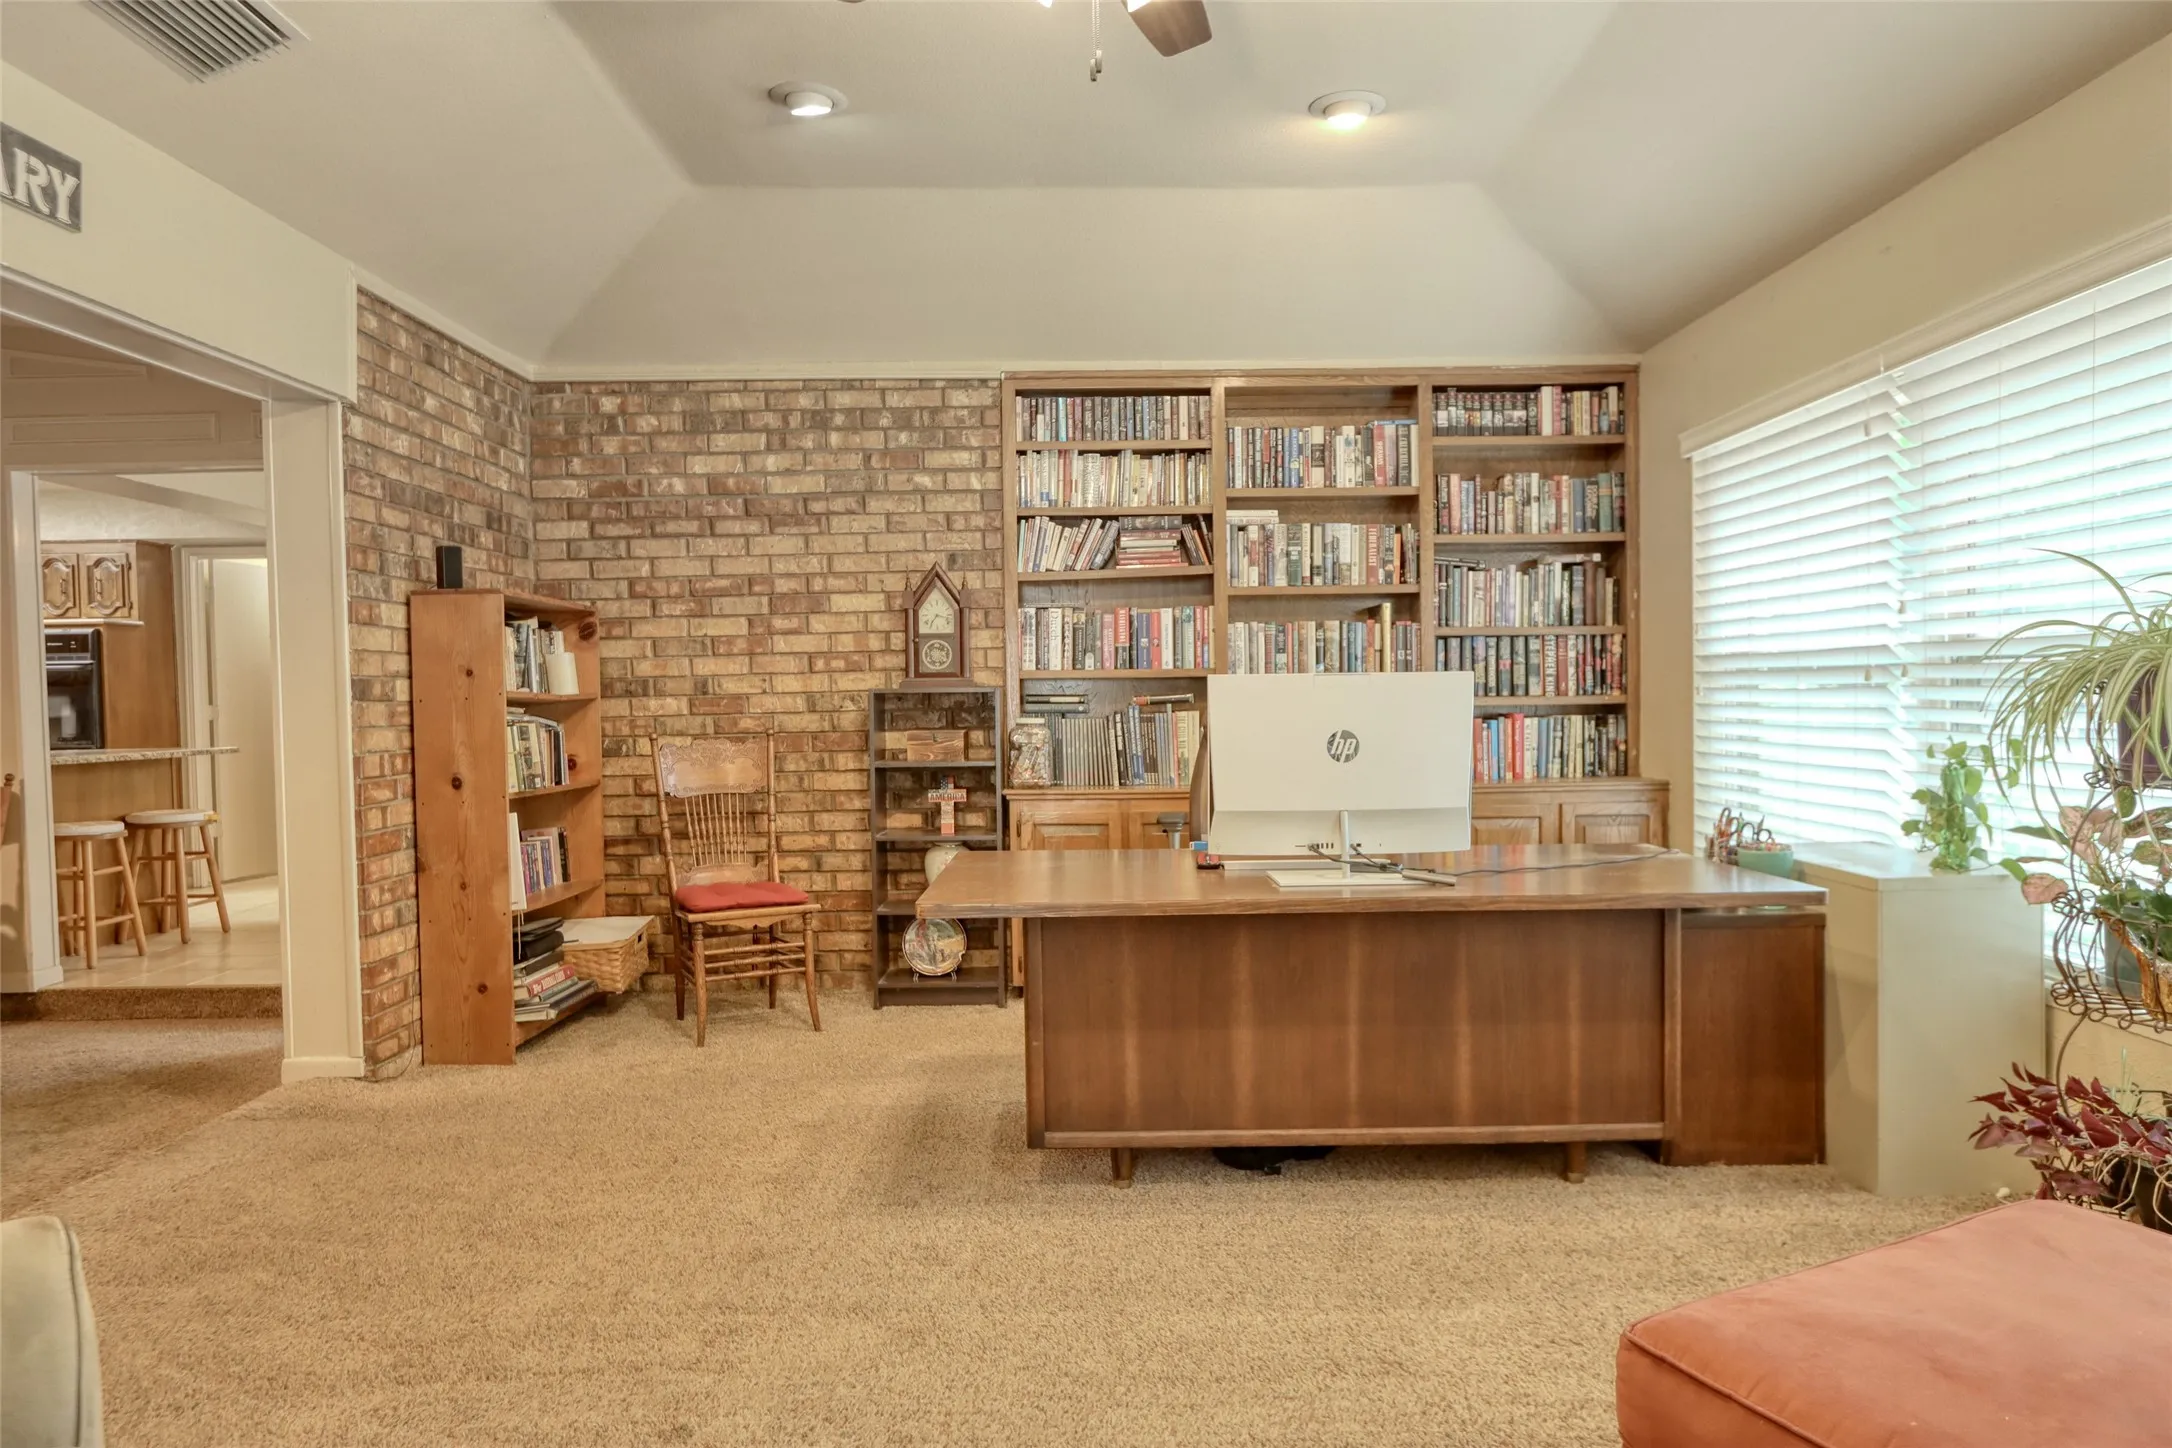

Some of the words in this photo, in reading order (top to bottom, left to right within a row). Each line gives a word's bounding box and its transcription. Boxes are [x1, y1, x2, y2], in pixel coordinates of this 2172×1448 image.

[1050, 611, 1060, 641] Dutch
[1544, 635, 1557, 674] STEPHEN
[1544, 676, 1557, 698] KING
[1330, 729, 1357, 764] hp
[930, 793, 965, 801] AMERICA
